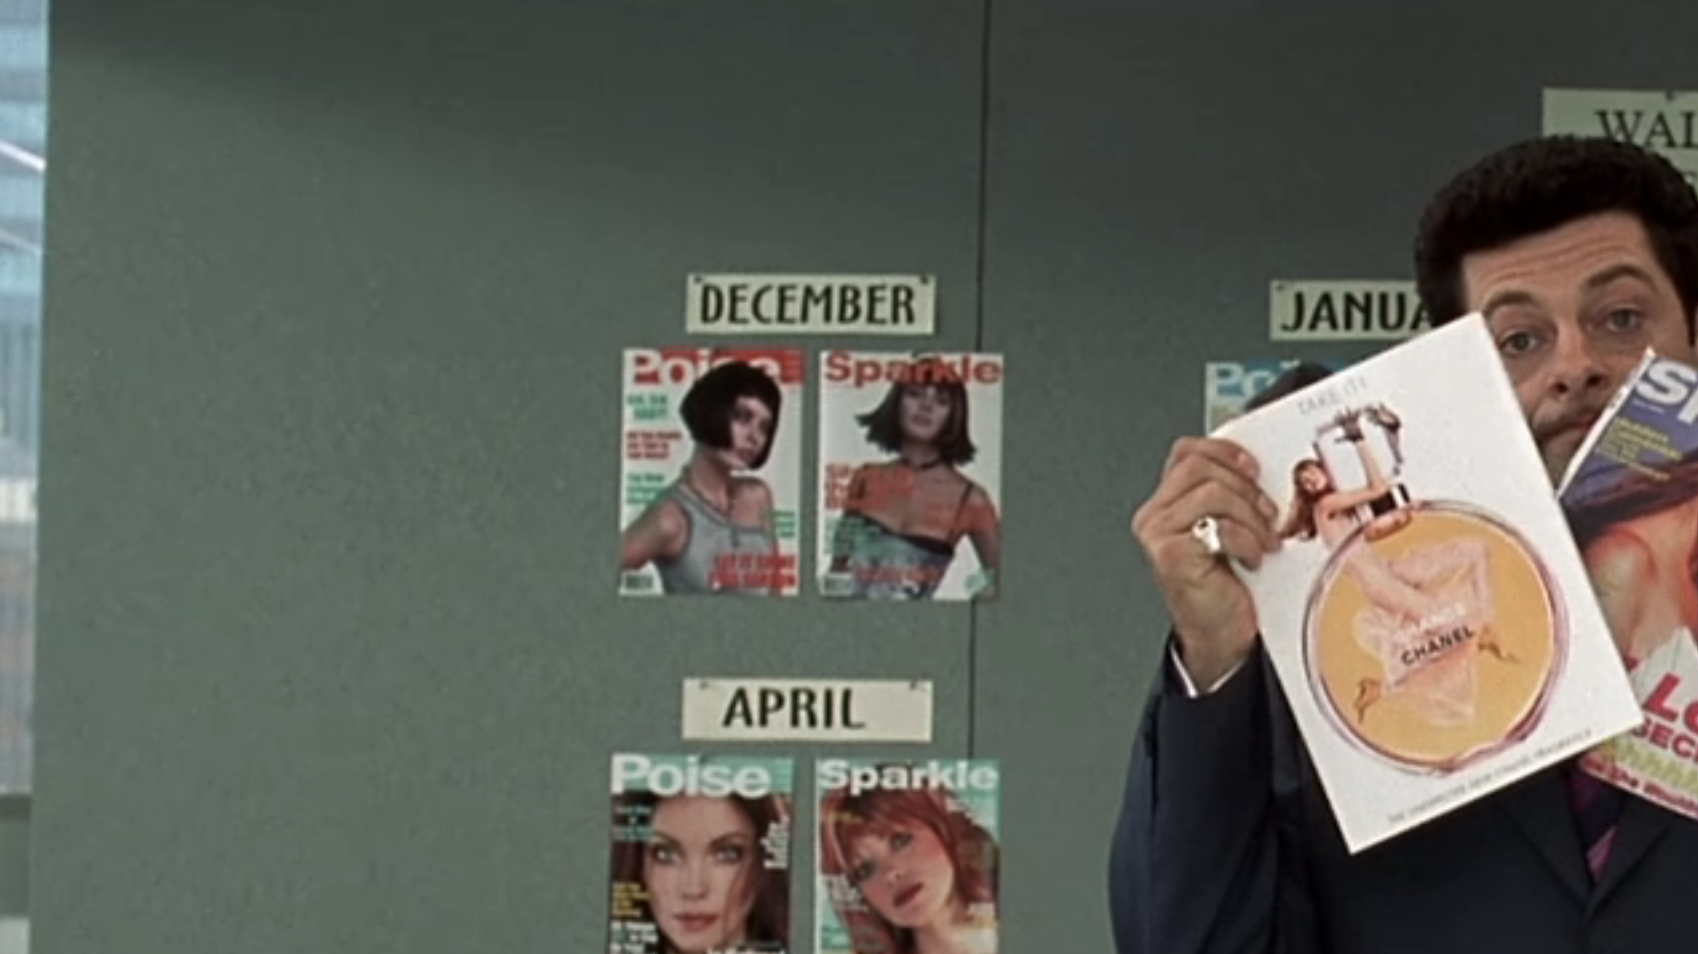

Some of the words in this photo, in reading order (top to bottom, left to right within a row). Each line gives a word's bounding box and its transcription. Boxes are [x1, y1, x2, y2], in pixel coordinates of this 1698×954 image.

[700, 283, 915, 325] DECEMBER
[1280, 290, 1437, 333] JANUA
[825, 351, 1003, 388] Sparkle
[1401, 624, 1476, 666] CHANEL
[722, 686, 867, 730] APRIL
[610, 753, 772, 799] Poise
[818, 759, 999, 796] Sparkle
